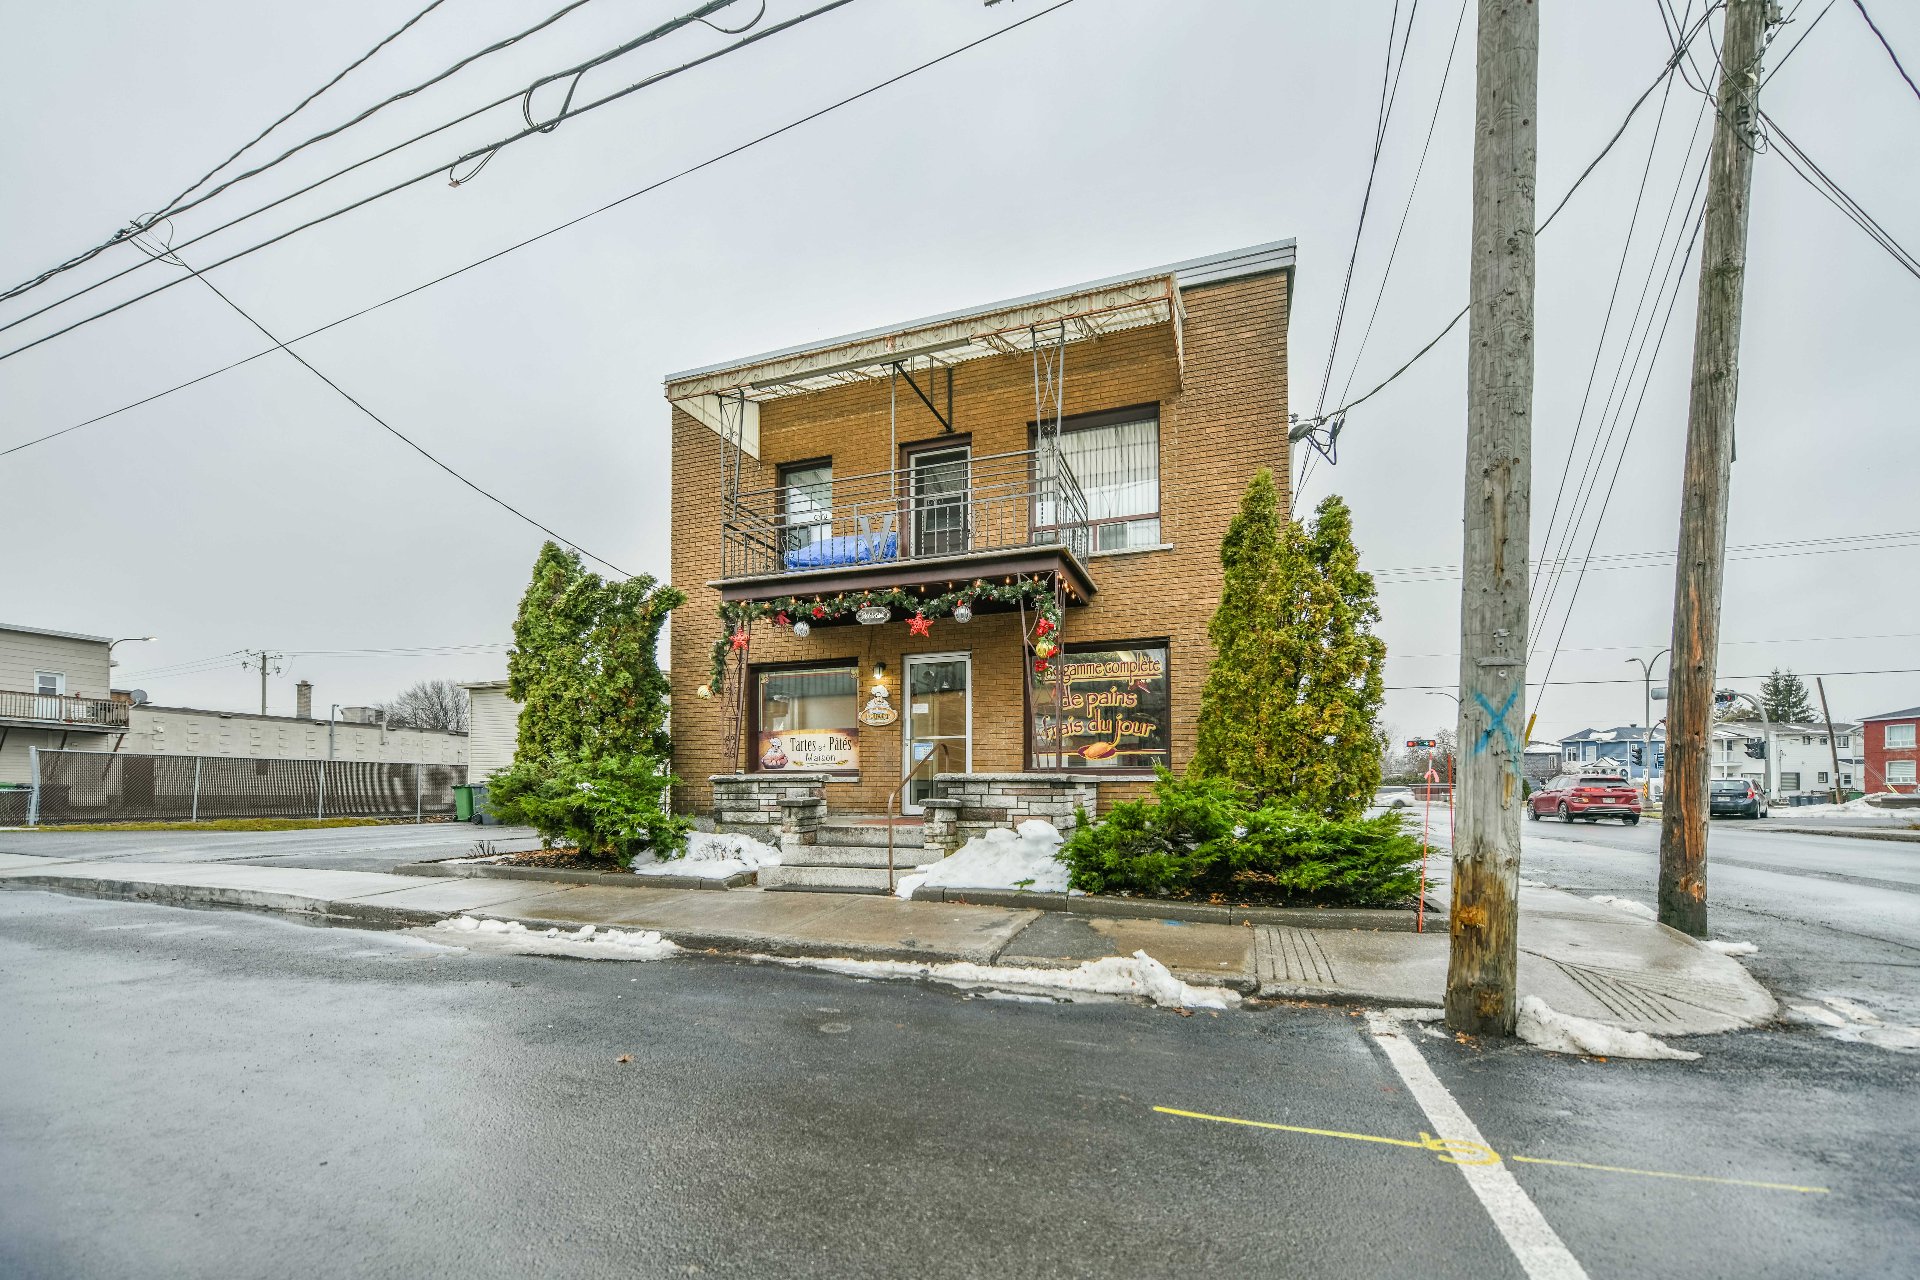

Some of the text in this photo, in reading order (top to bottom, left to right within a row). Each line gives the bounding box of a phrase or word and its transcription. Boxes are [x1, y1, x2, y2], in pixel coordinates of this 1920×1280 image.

[1062, 663, 1104, 685] gamme
[1104, 652, 1161, 685] complète
[1062, 685, 1138, 718] de pains
[789, 737, 816, 752] Tartes
[829, 736, 852, 751] Pâtés
[1042, 707, 1157, 748] frais du jour
[805, 753, 836, 762] Maison
